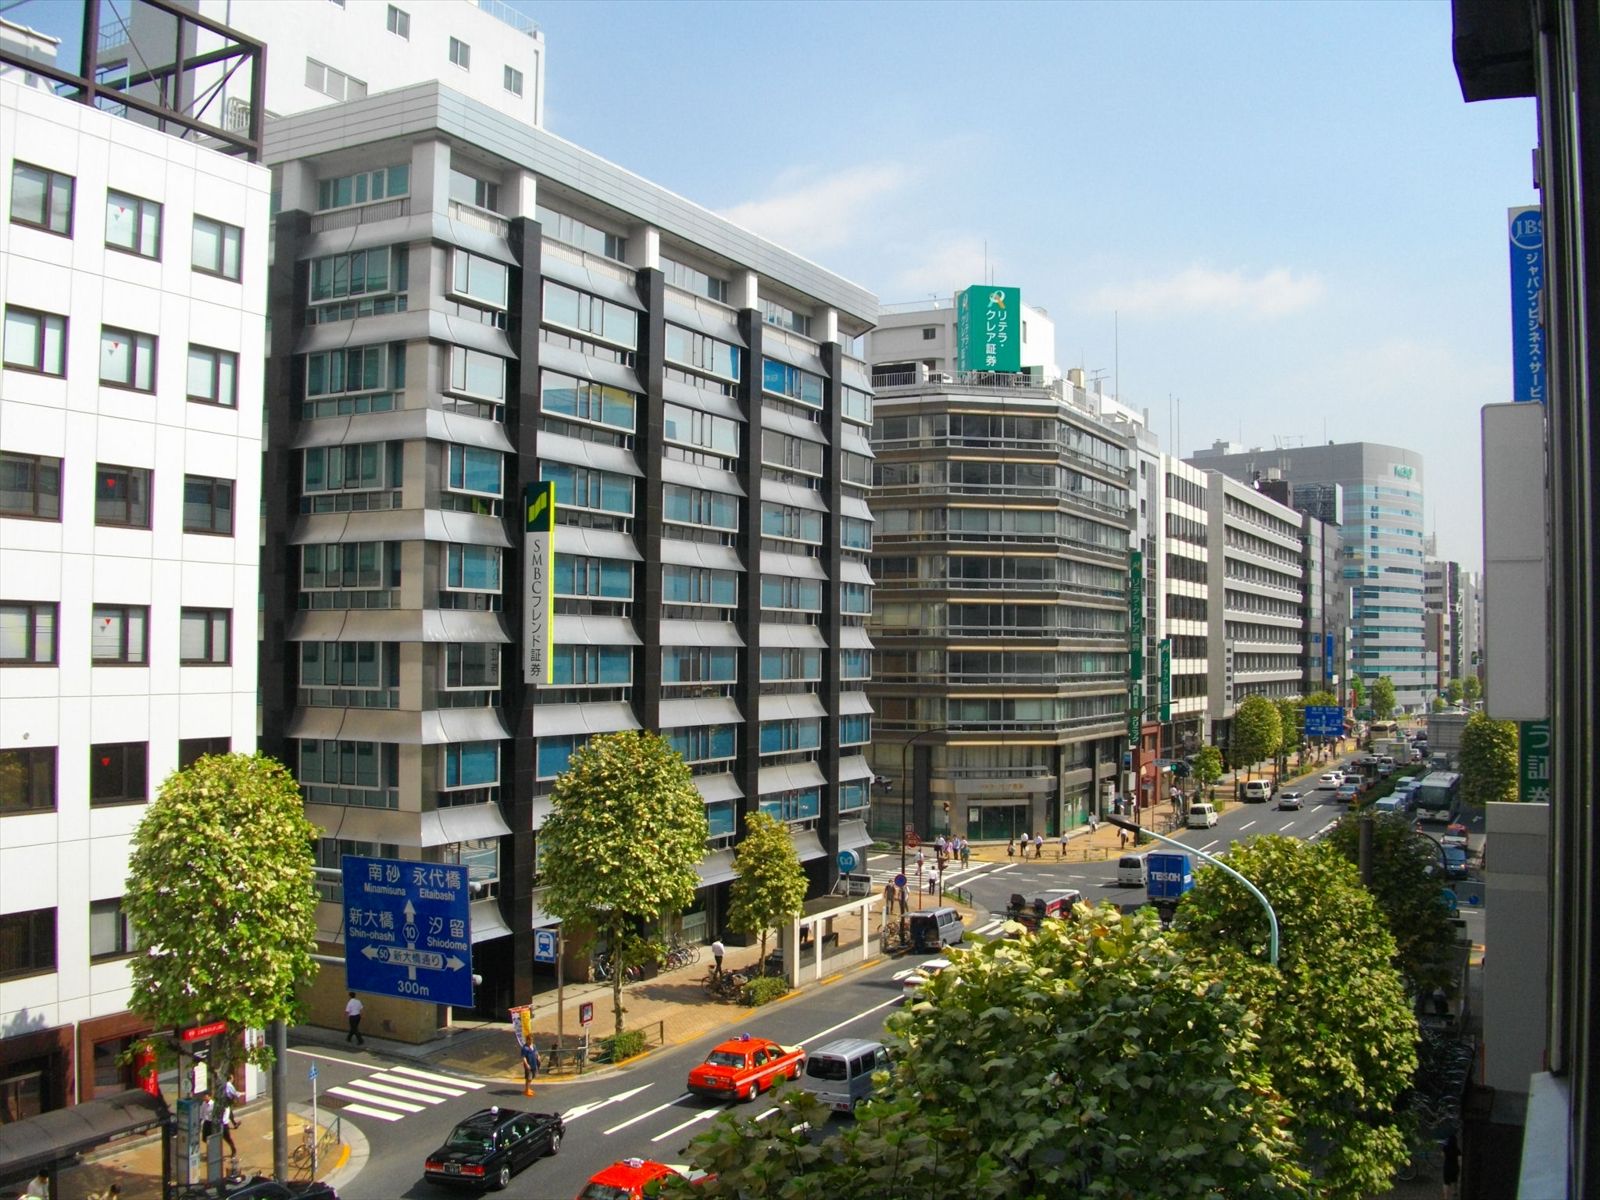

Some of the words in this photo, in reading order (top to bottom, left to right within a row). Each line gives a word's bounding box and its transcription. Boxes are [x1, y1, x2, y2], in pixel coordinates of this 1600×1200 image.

[986, 310, 997, 367] クレア証券
[1526, 252, 1542, 403] ジャパン・ビジネス・サービ
[531, 539, 542, 677] SMBCフレンド証券
[368, 863, 400, 883] 南砂
[413, 867, 461, 890] 永代橋
[364, 882, 406, 896] Minamisuna
[419, 887, 455, 901] Eitaibashi
[349, 907, 394, 930] 新大橋
[428, 916, 464, 938] 汐留
[405, 926, 416, 940] 10
[349, 927, 395, 942] Shin-ohashi
[427, 937, 468, 951] Shiodome
[393, 950, 440, 966] 新大橋通り
[397, 980, 430, 996] 300m
